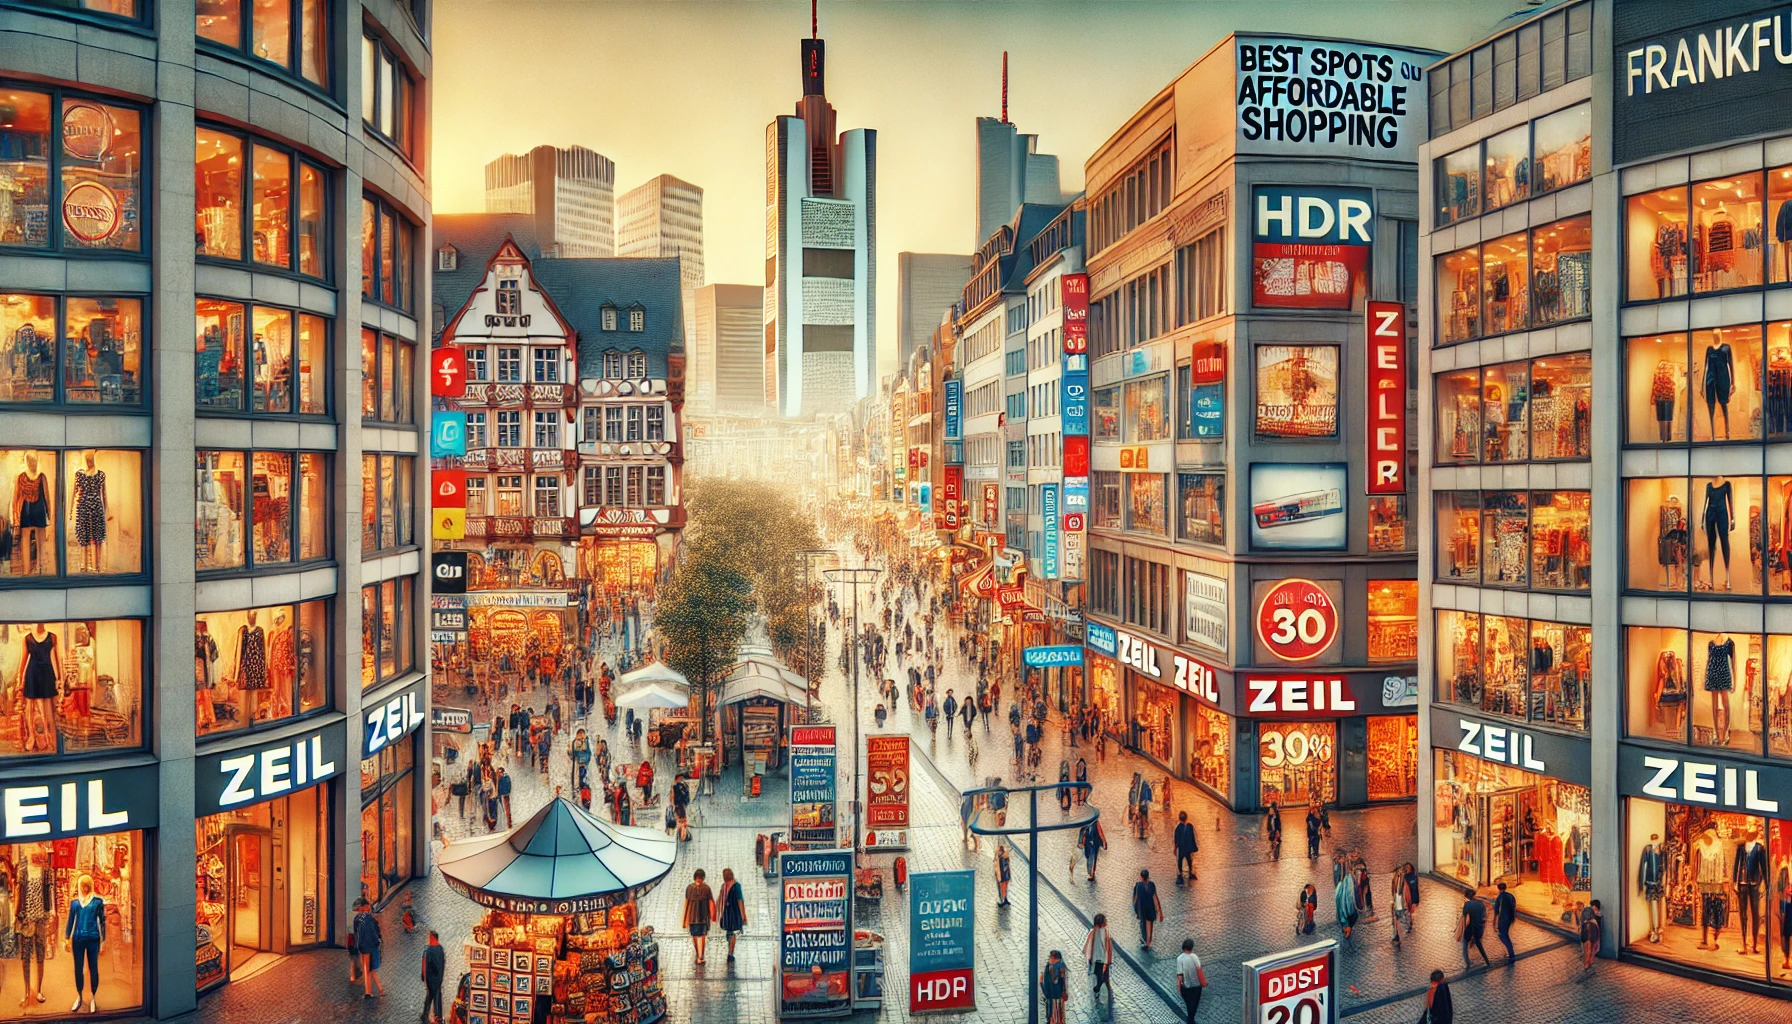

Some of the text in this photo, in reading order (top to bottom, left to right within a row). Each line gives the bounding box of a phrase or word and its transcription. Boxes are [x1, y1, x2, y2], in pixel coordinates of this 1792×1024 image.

[1240, 45, 1303, 74] BEST
[1310, 48, 1394, 82] SPOTS
[1627, 15, 1792, 97] FRANKFU
[1238, 75, 1407, 116] AFFORDABLE
[1241, 106, 1398, 148] SHOPPING
[1258, 195, 1372, 242] HDR
[1271, 608, 1326, 645] 30
[1117, 631, 1161, 678] ZEIL
[1174, 655, 1218, 703] ZEIL
[1249, 680, 1355, 712] ZEIL
[368, 692, 424, 753] ZEIL
[1458, 719, 1545, 772] ZEIL
[219, 734, 335, 806] ZEIL
[1643, 755, 1779, 813] ZEIL
